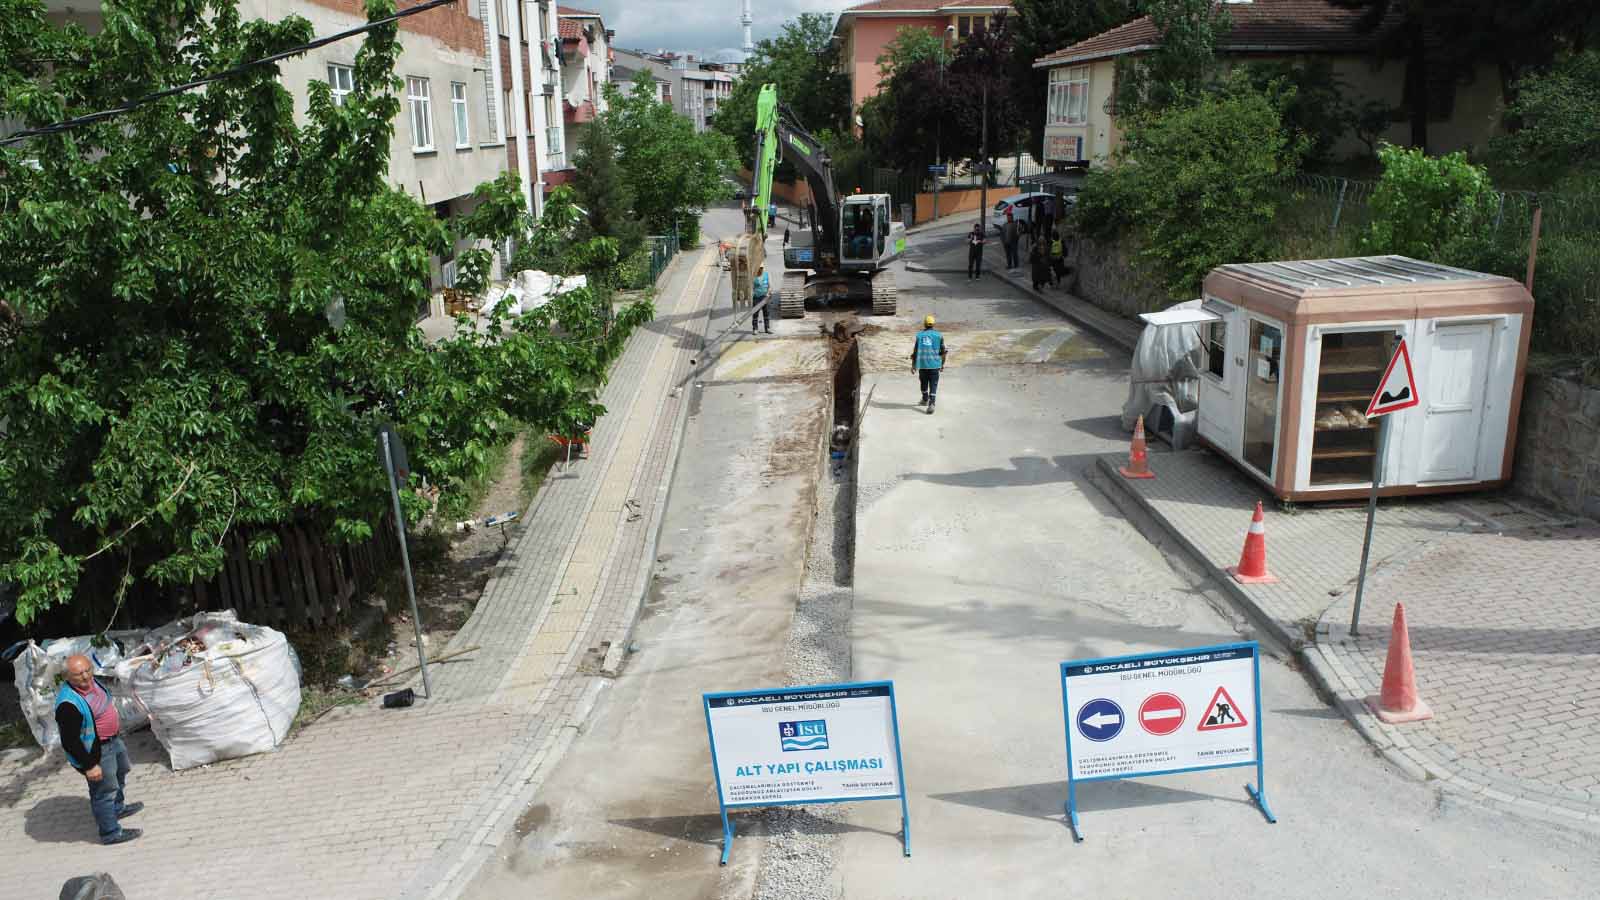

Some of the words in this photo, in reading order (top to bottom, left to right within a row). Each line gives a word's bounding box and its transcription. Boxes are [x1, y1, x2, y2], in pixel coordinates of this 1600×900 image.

[799, 723, 825, 736] İSU
[736, 764, 762, 777] ALT
[766, 762, 800, 775] YAPI
[804, 758, 883, 774] ÇALIŞMASI
